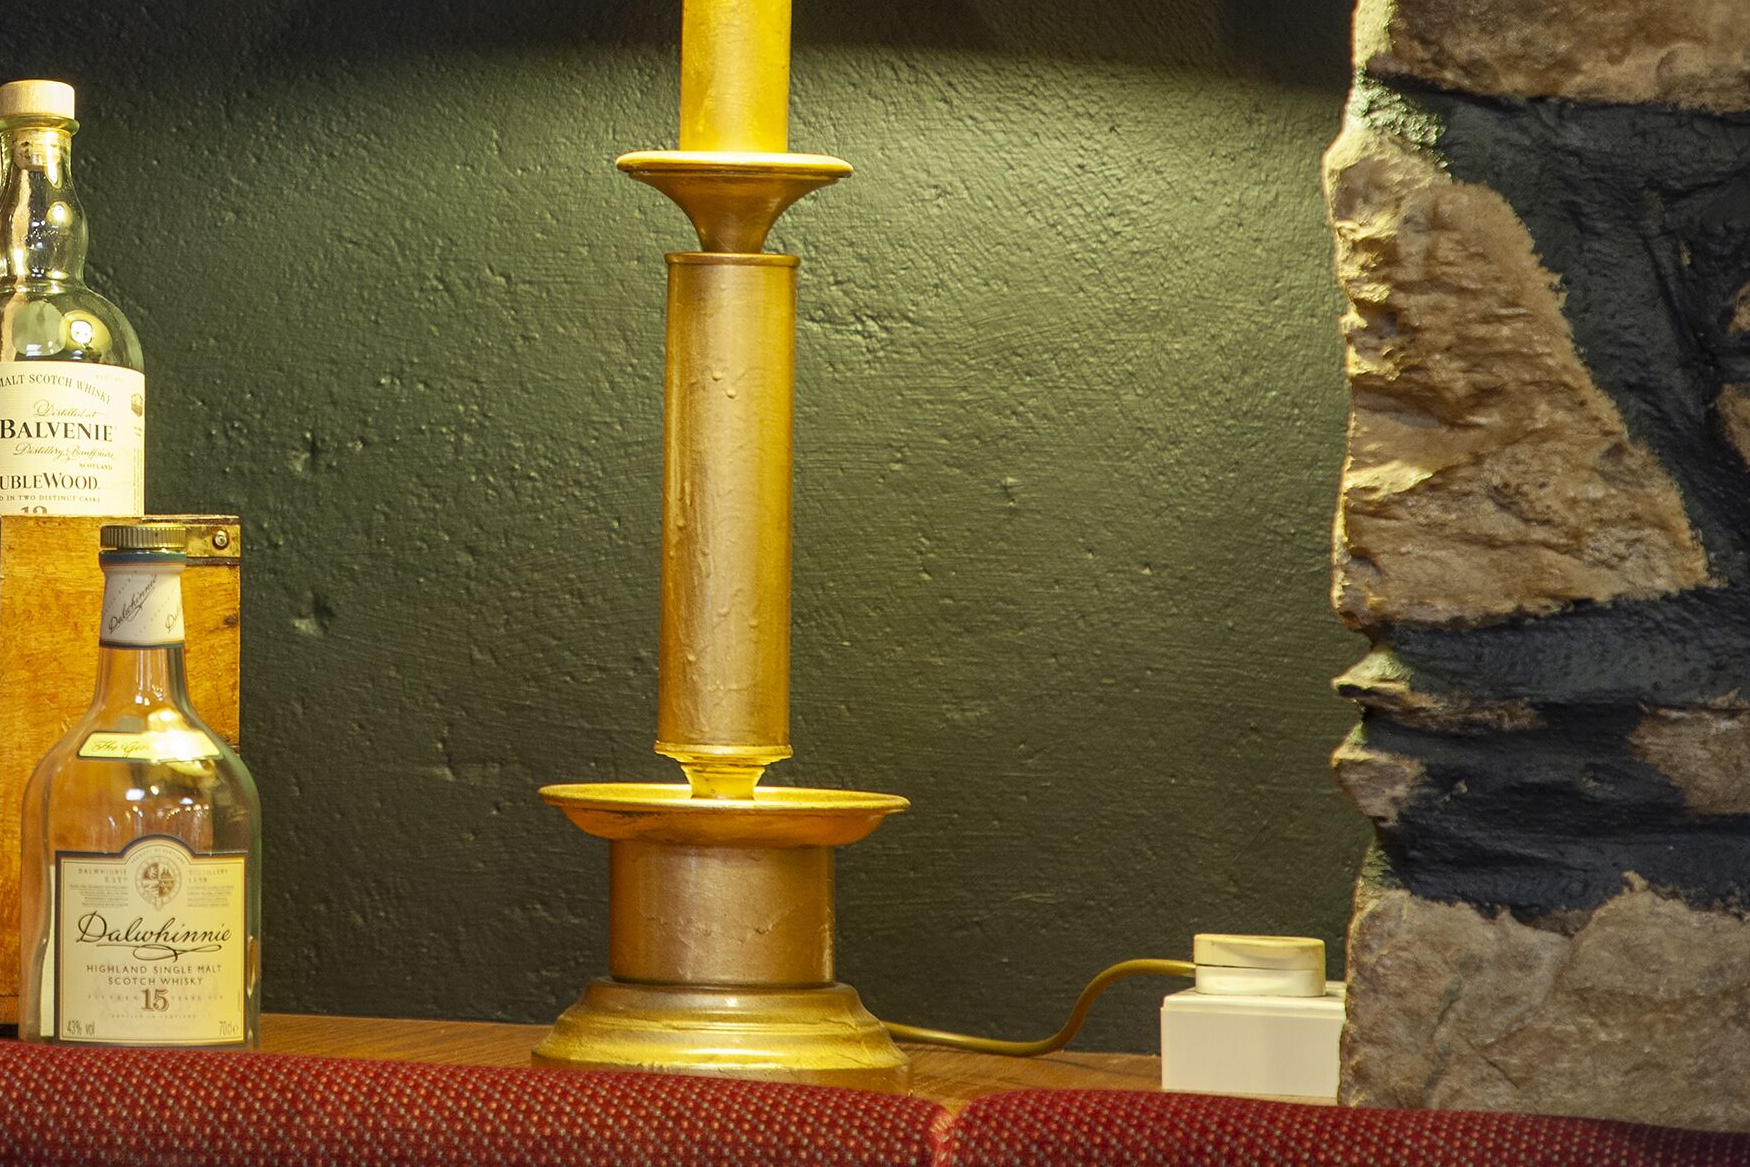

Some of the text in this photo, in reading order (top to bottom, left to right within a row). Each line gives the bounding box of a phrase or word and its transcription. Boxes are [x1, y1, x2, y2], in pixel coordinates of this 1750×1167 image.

[29, 374, 72, 388] SCOTCH
[76, 380, 113, 405] WHISKY
[33, 399, 83, 417] Distilled
[0, 418, 113, 443] BALVENIE
[79, 462, 113, 471] SCOTLAND
[39, 494, 76, 502] DISTINCT
[76, 910, 232, 946] Dalwhinnie
[87, 964, 221, 974] HIGHLAND SINGLE MALT
[108, 977, 203, 985] SCOTCH WHISKY
[141, 988, 169, 1012] 15
[67, 1020, 82, 1036] 43%
[86, 1021, 96, 1036] vol
